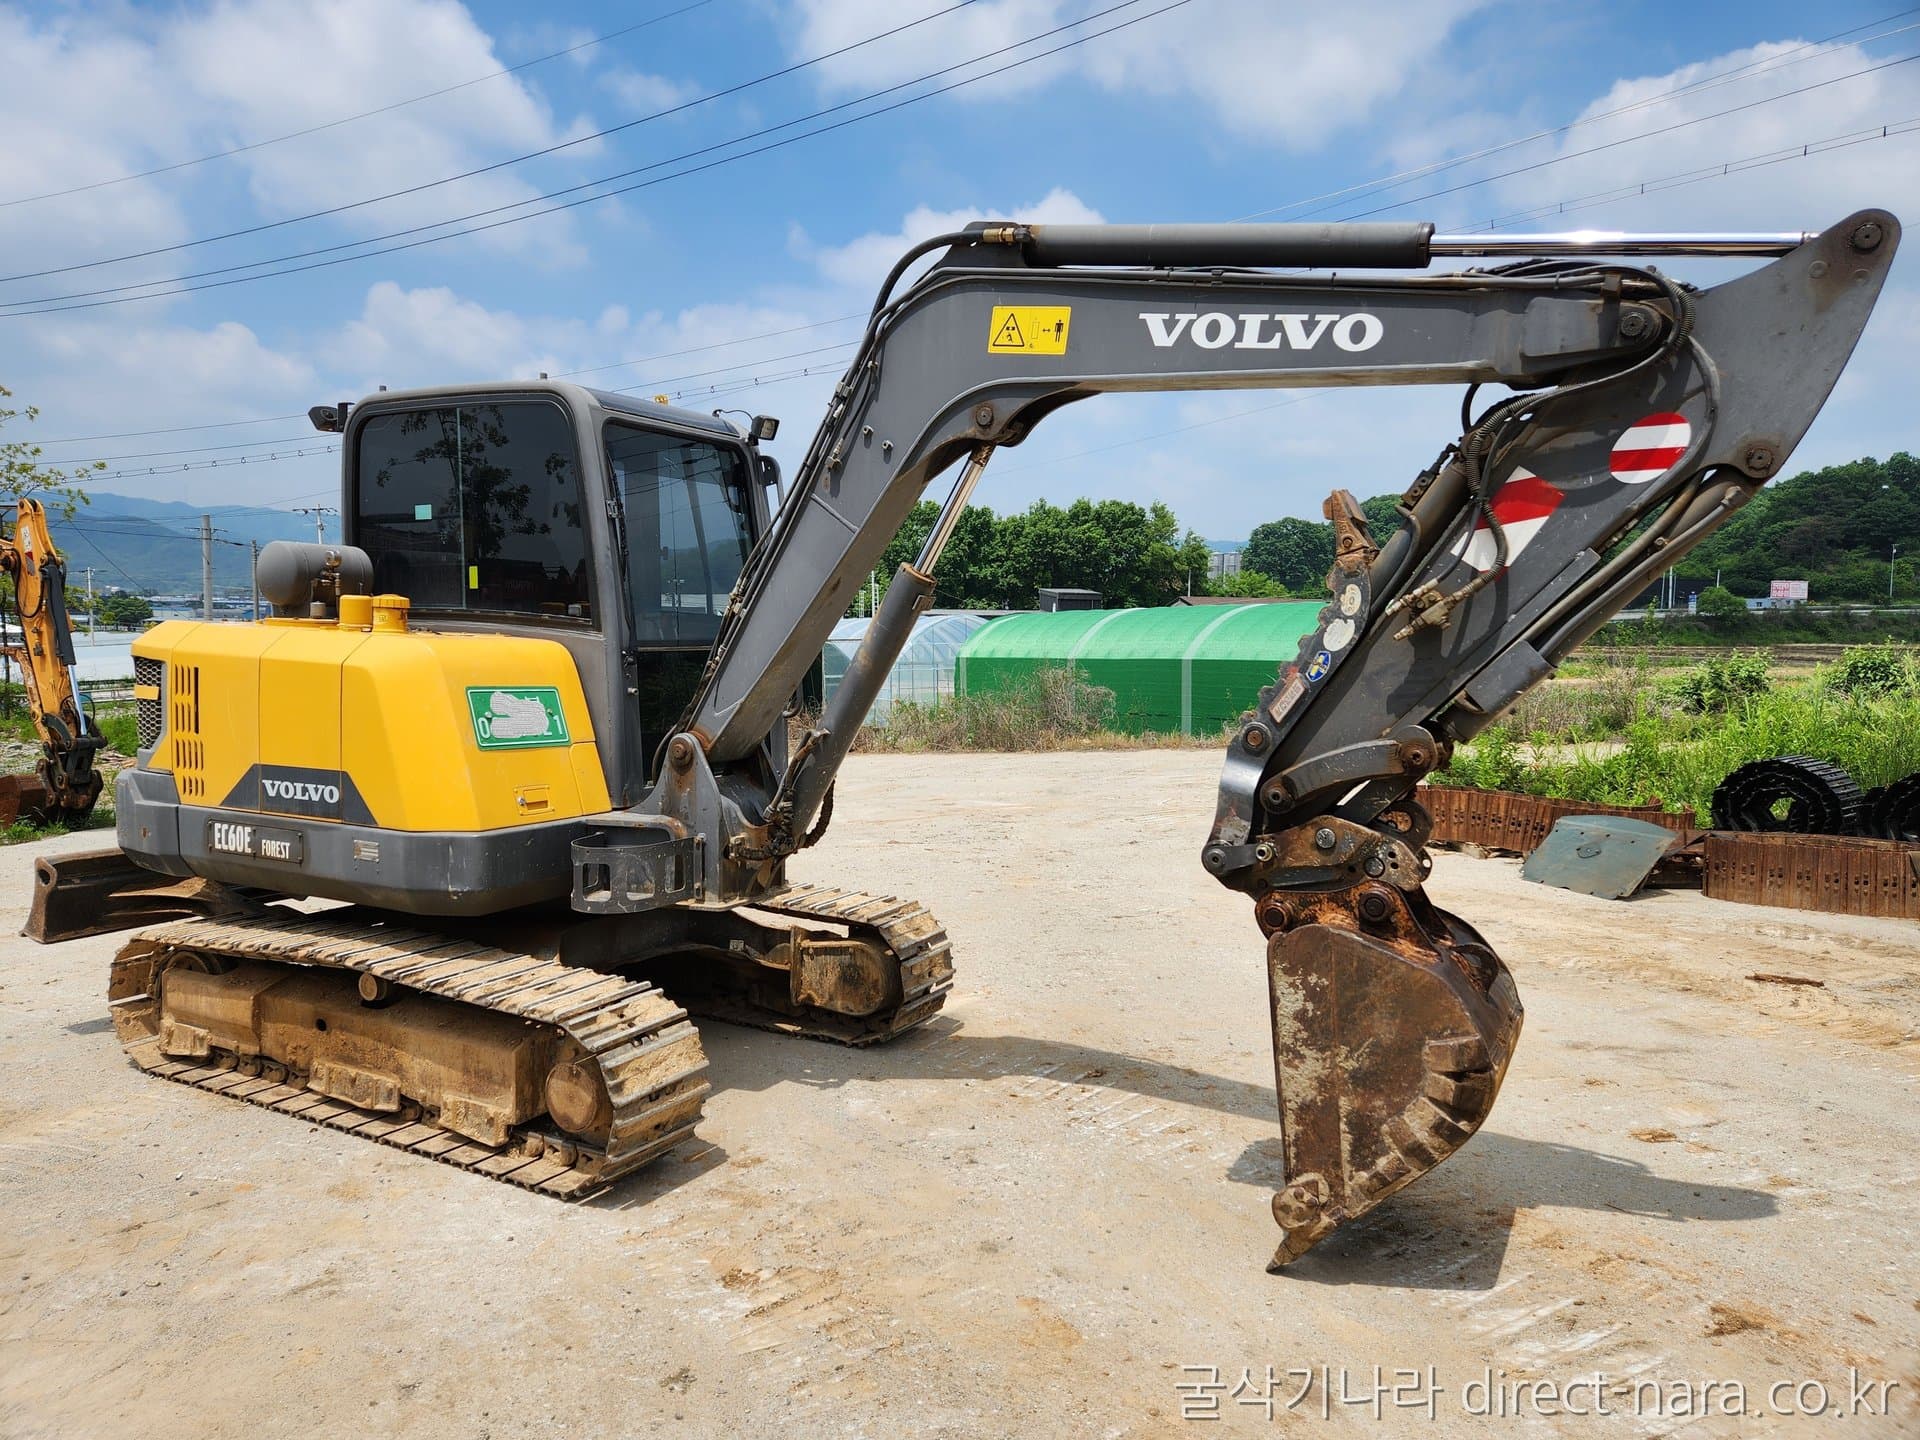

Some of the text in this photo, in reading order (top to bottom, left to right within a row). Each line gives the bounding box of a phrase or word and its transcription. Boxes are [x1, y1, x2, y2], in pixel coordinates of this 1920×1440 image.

[1139, 312, 1384, 352] VOLVO
[262, 780, 340, 803] VOLVO
[214, 822, 290, 859] EC60E FOREST
